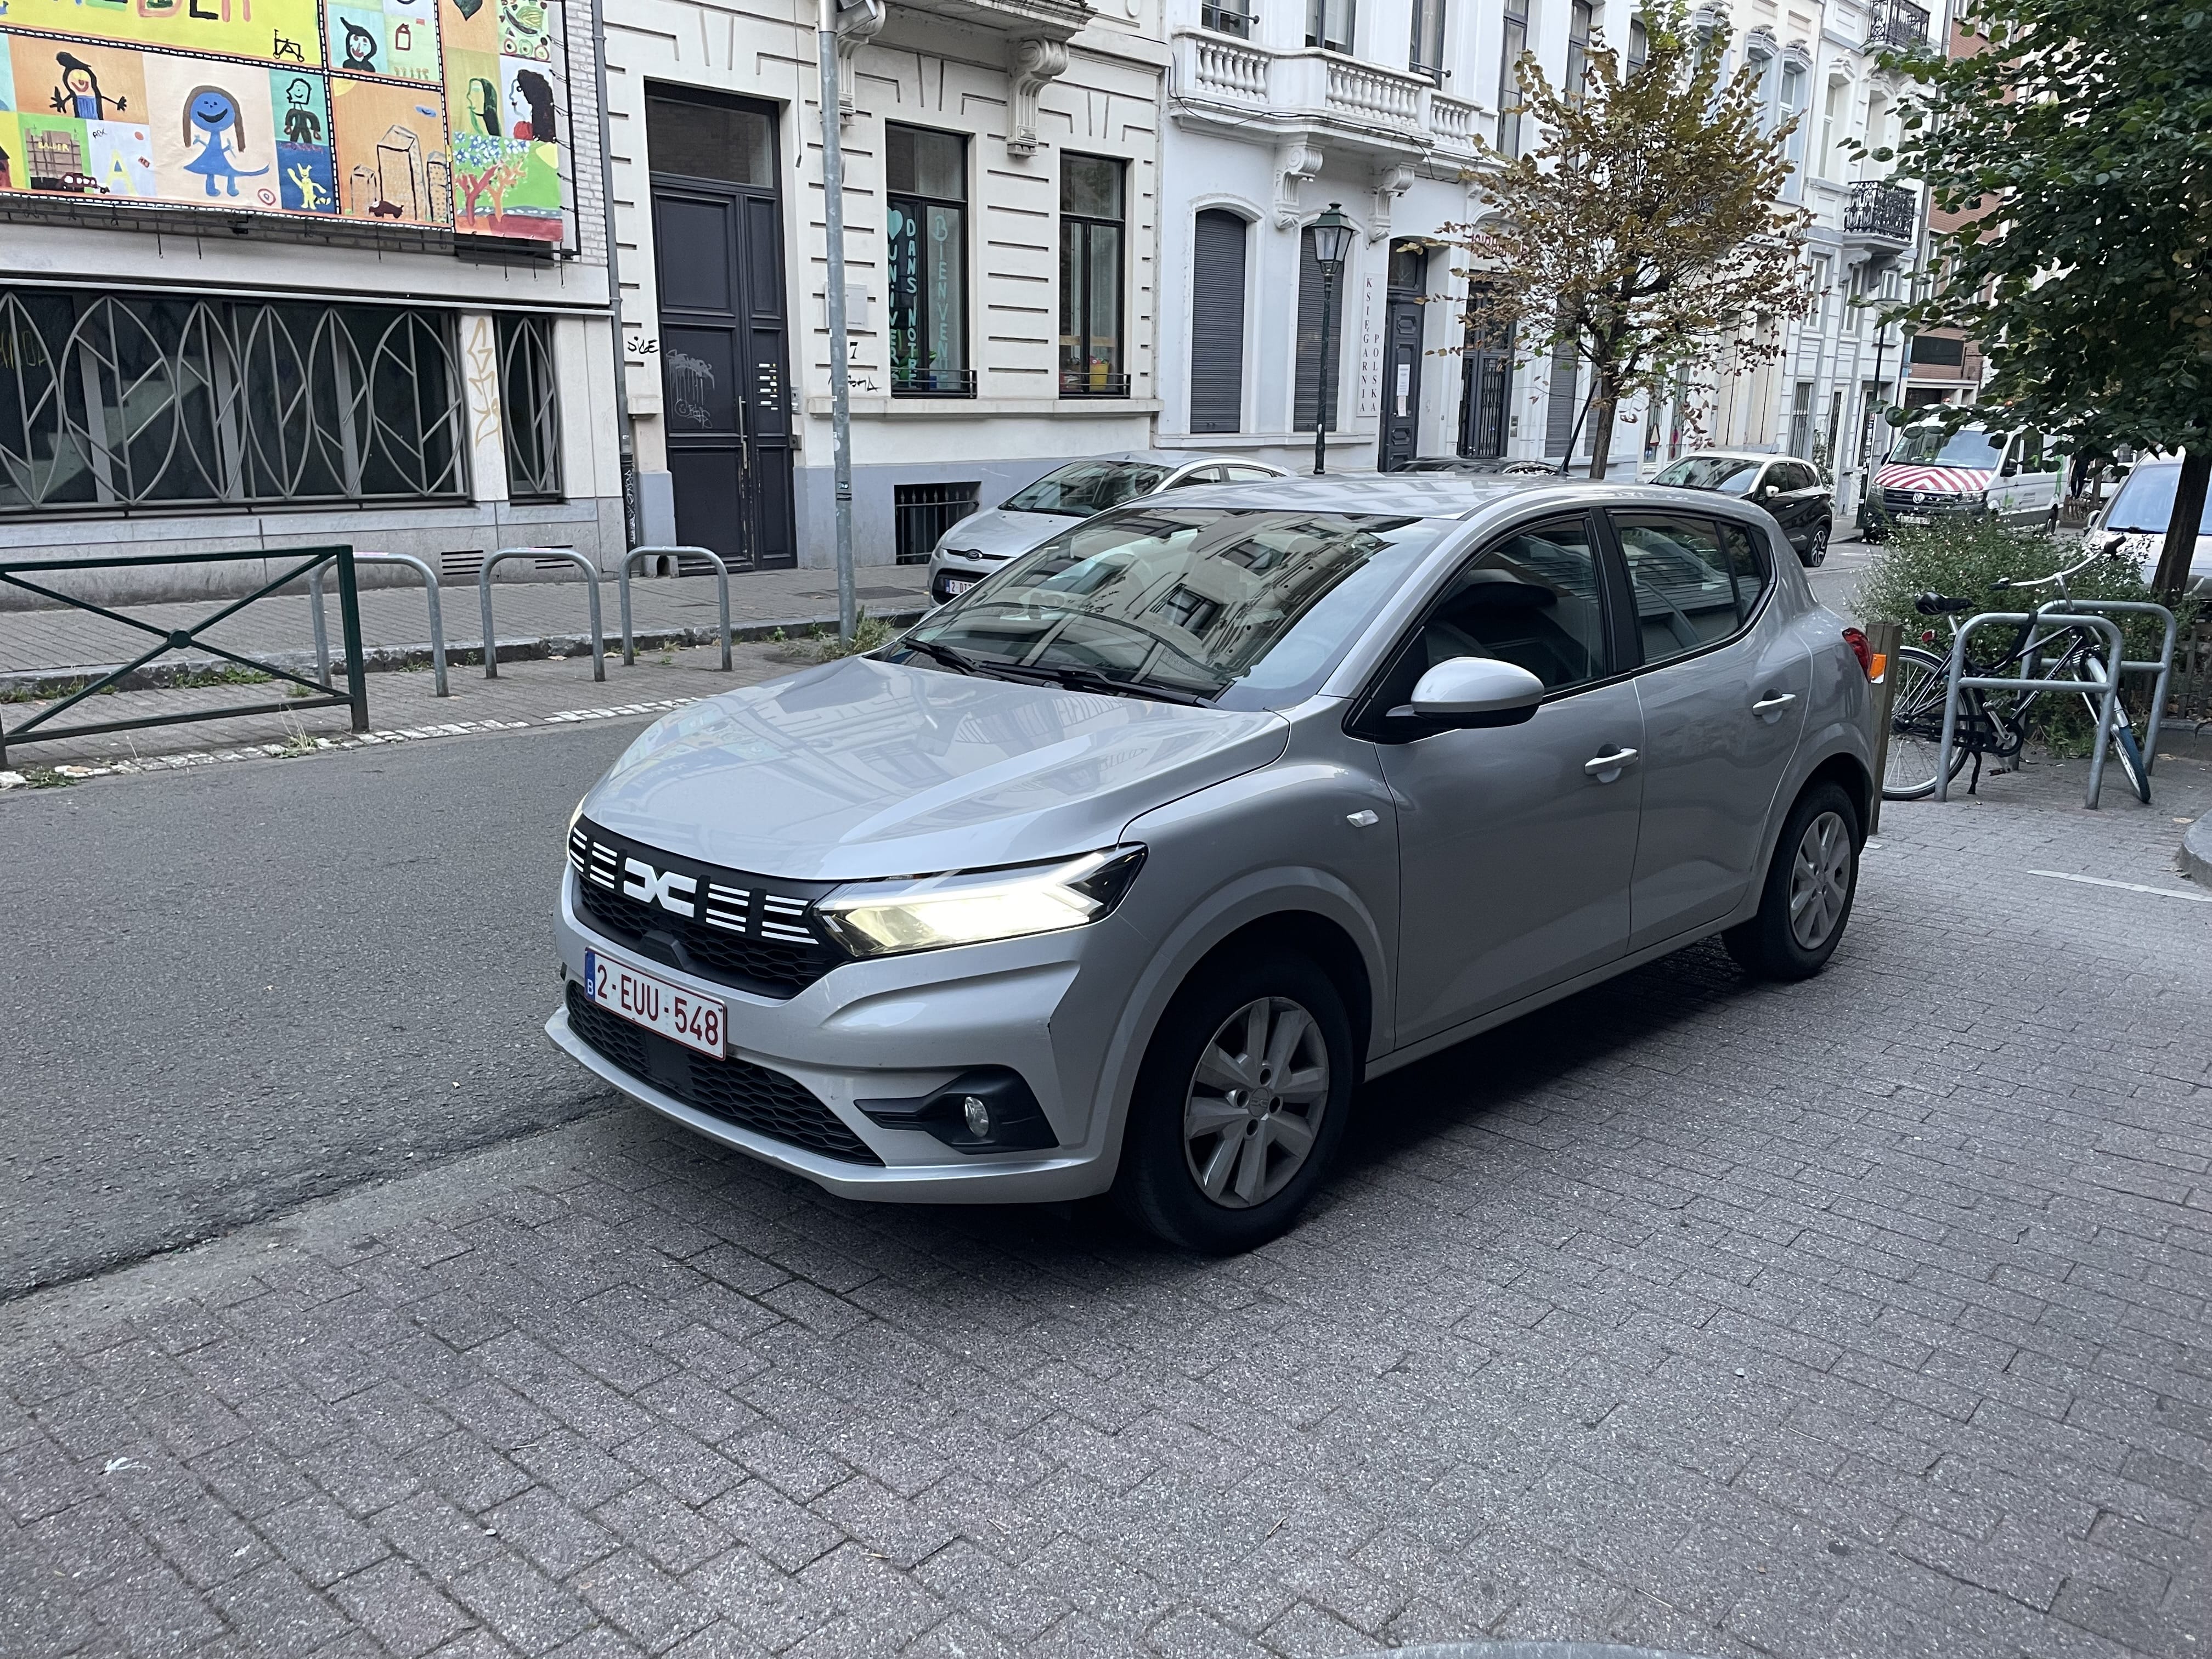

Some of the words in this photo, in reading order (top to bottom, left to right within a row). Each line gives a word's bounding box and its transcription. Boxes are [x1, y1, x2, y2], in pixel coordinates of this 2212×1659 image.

[906, 218, 917, 294] DANS
[849, 341, 859, 359] 7
[907, 297, 917, 389] NOTRE
[1359, 278, 1373, 412] KSIĘGARNIA
[1371, 334, 1379, 412] POLSKA
[587, 978, 594, 996] B
[597, 964, 719, 1046] 2-EUU-548
